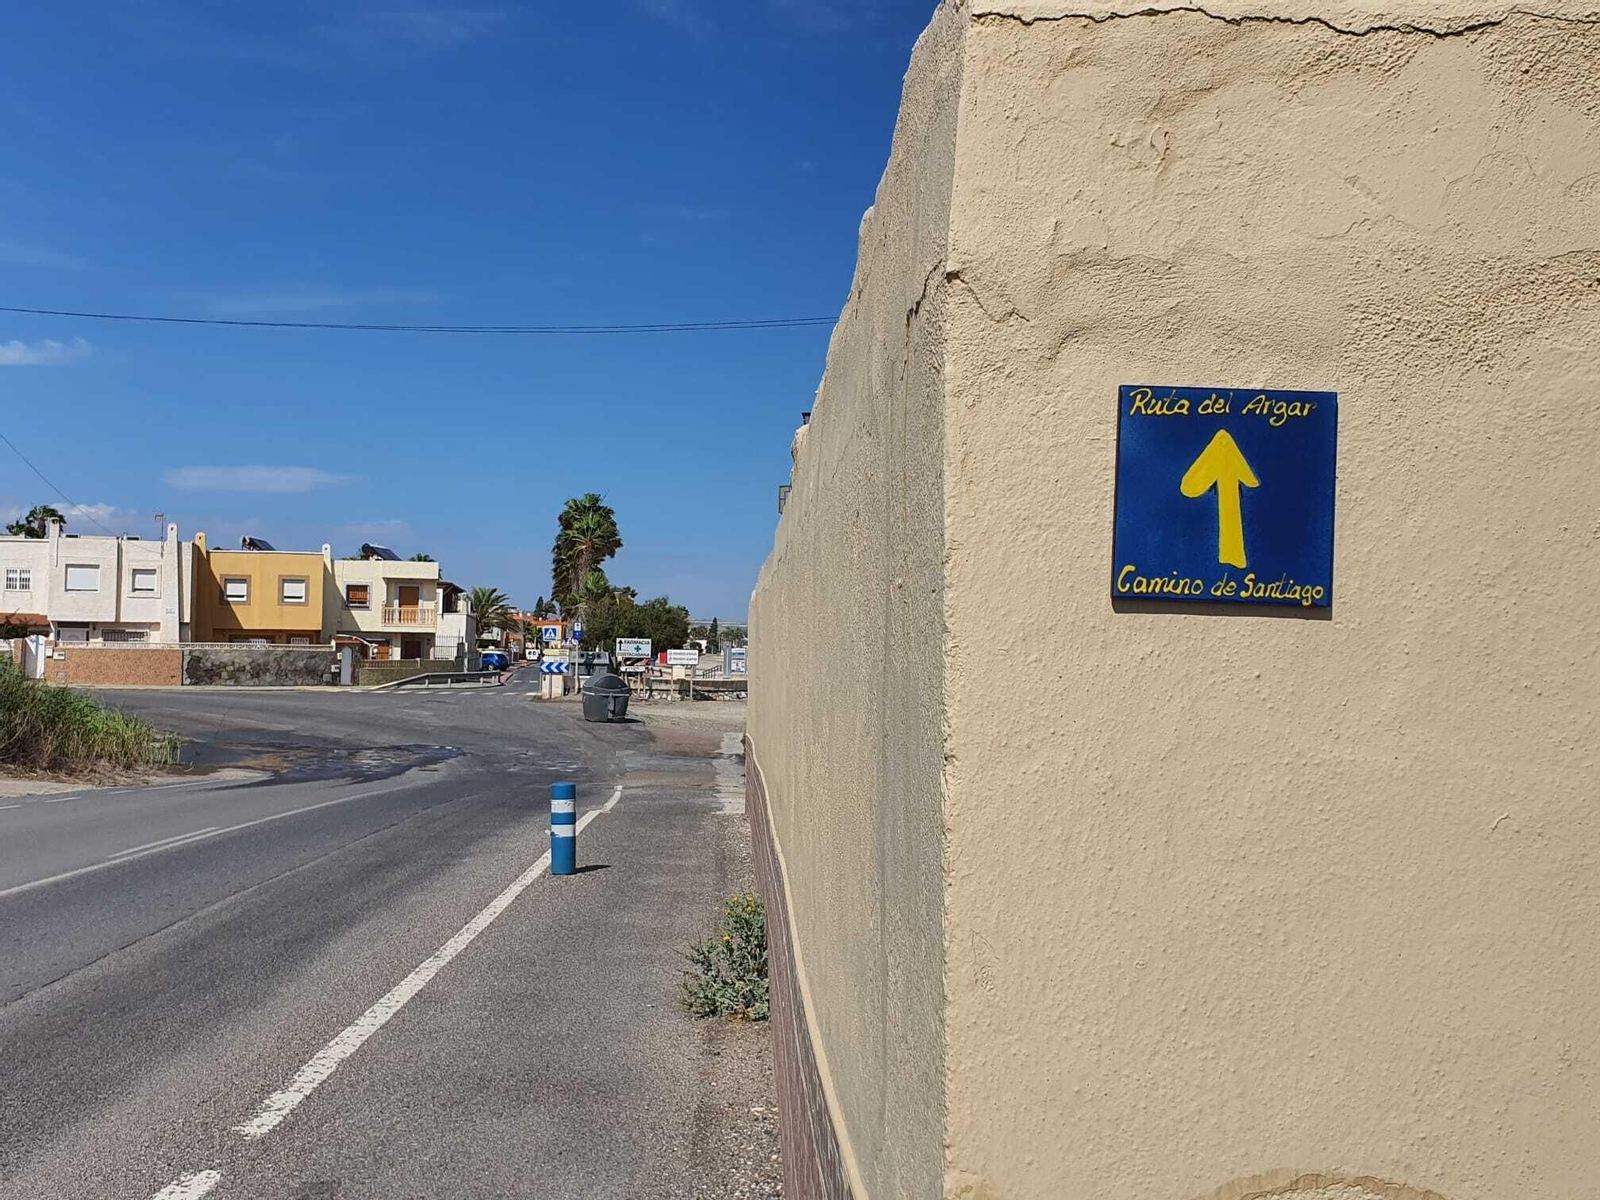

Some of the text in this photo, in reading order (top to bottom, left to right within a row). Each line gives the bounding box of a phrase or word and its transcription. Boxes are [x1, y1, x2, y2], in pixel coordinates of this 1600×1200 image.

[1129, 387, 1317, 427] Ruta del Argar
[1117, 565, 1324, 606] Camino de Santiago
